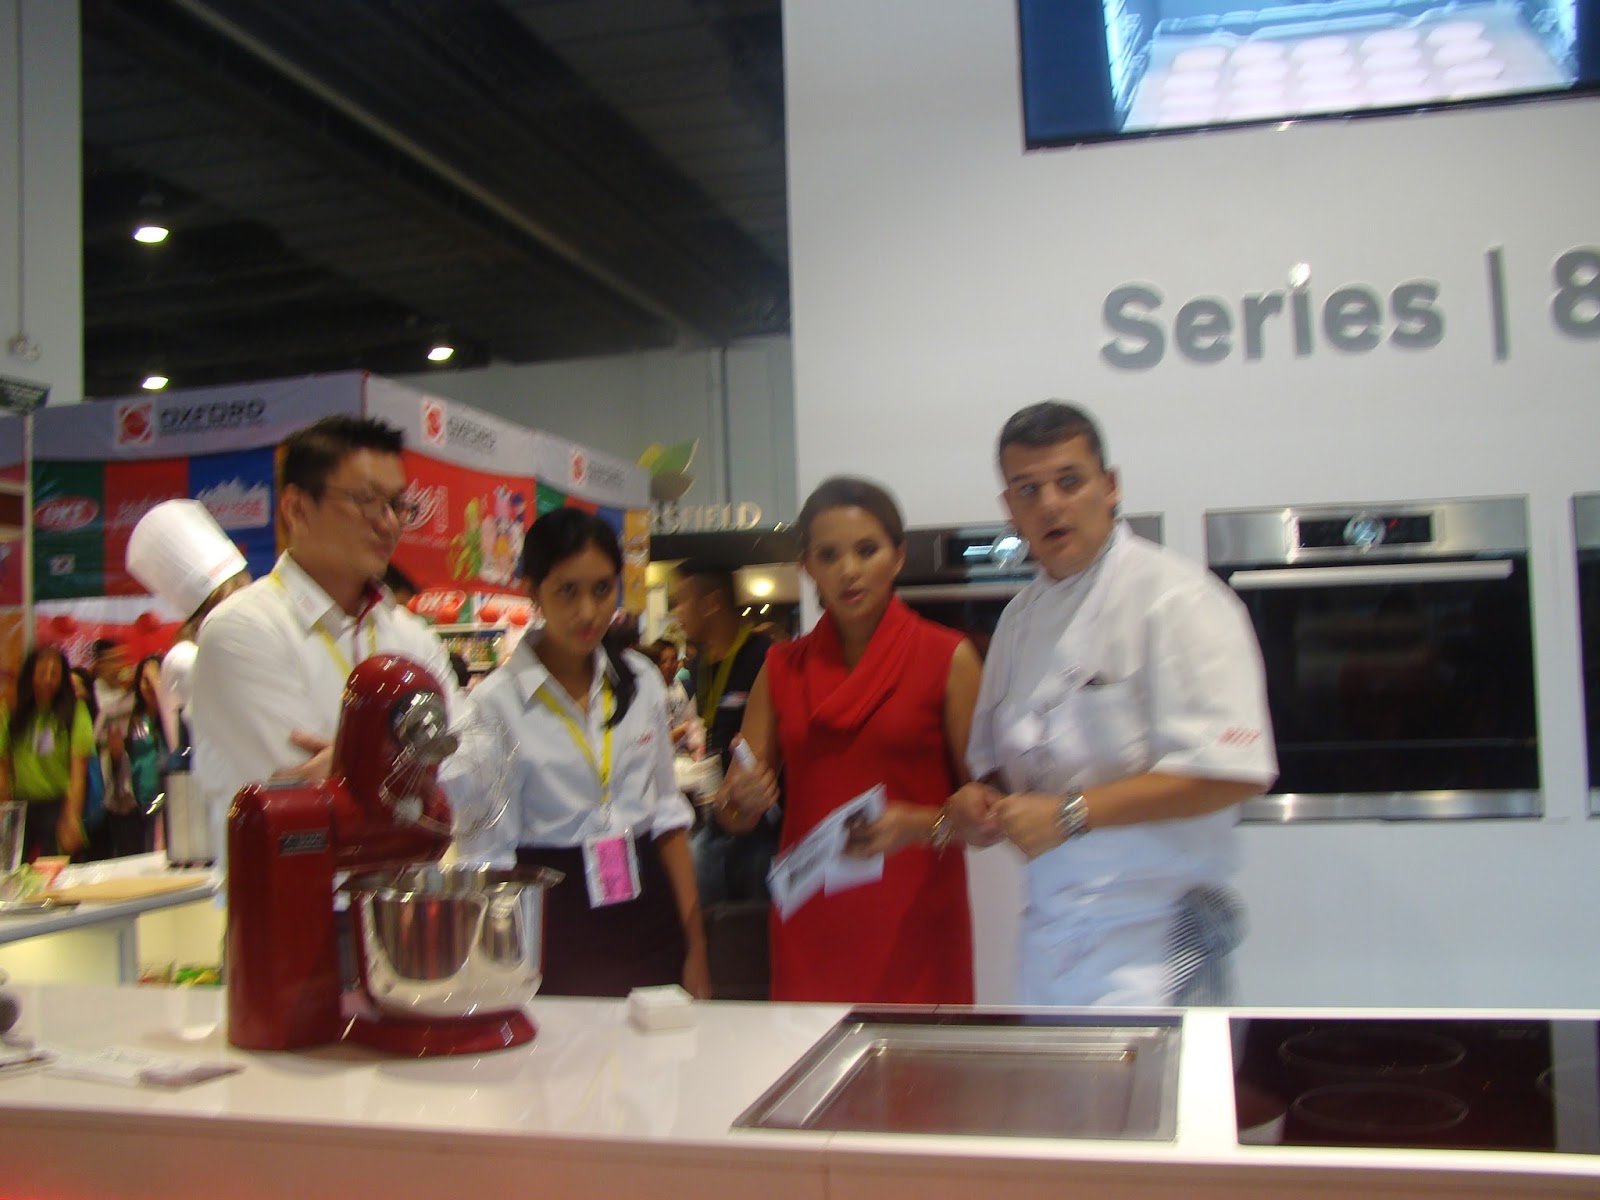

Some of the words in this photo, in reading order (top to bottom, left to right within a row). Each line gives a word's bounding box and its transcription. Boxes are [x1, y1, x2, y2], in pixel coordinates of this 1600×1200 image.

[1100, 261, 1445, 371] Series
[1552, 245, 1600, 340] 8
[160, 399, 267, 429] OXFORD
